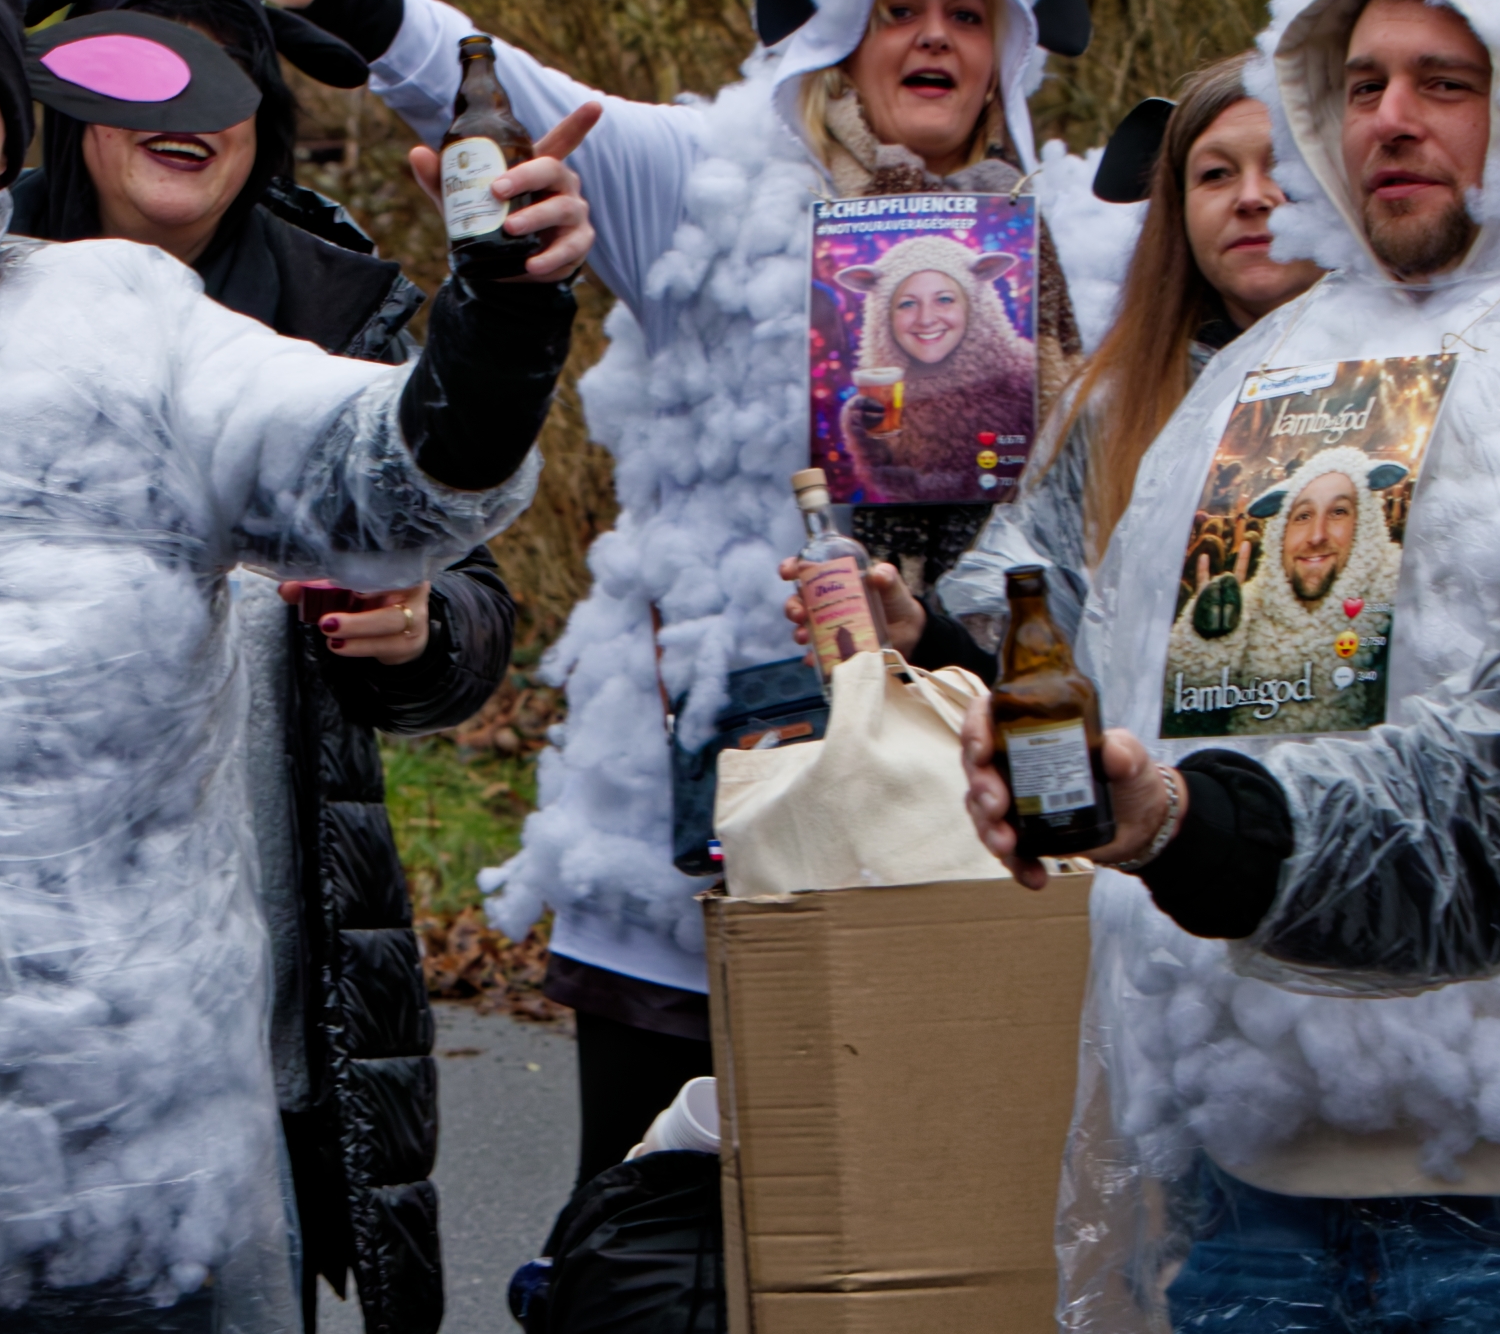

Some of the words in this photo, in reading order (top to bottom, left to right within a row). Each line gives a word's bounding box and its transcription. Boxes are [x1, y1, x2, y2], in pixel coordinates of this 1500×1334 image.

[817, 196, 978, 219] #CHEAPFLUENCER
[815, 218, 978, 236] #NOTYOURAVERAGESHEEP
[1270, 397, 1331, 437] lamb
[1323, 396, 1377, 444] god
[1173, 666, 1241, 714] lamb
[1253, 660, 1316, 720] god
